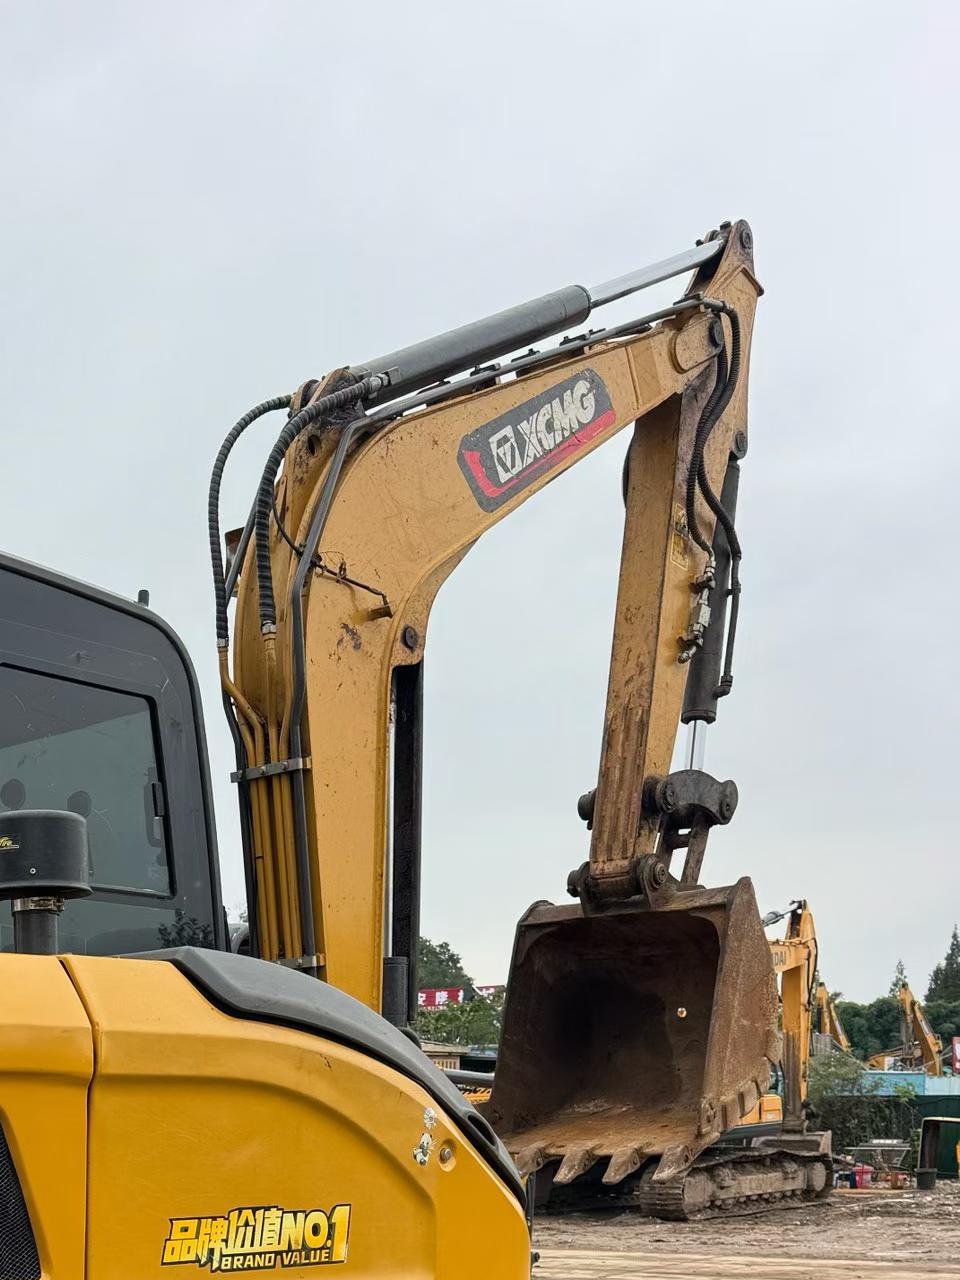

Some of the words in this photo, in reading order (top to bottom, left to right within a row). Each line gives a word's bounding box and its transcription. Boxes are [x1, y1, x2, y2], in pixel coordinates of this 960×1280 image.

[517, 379, 596, 468] XCMG
[221, 1253, 276, 1269] BRAND
[283, 1249, 330, 1265] VALUE
